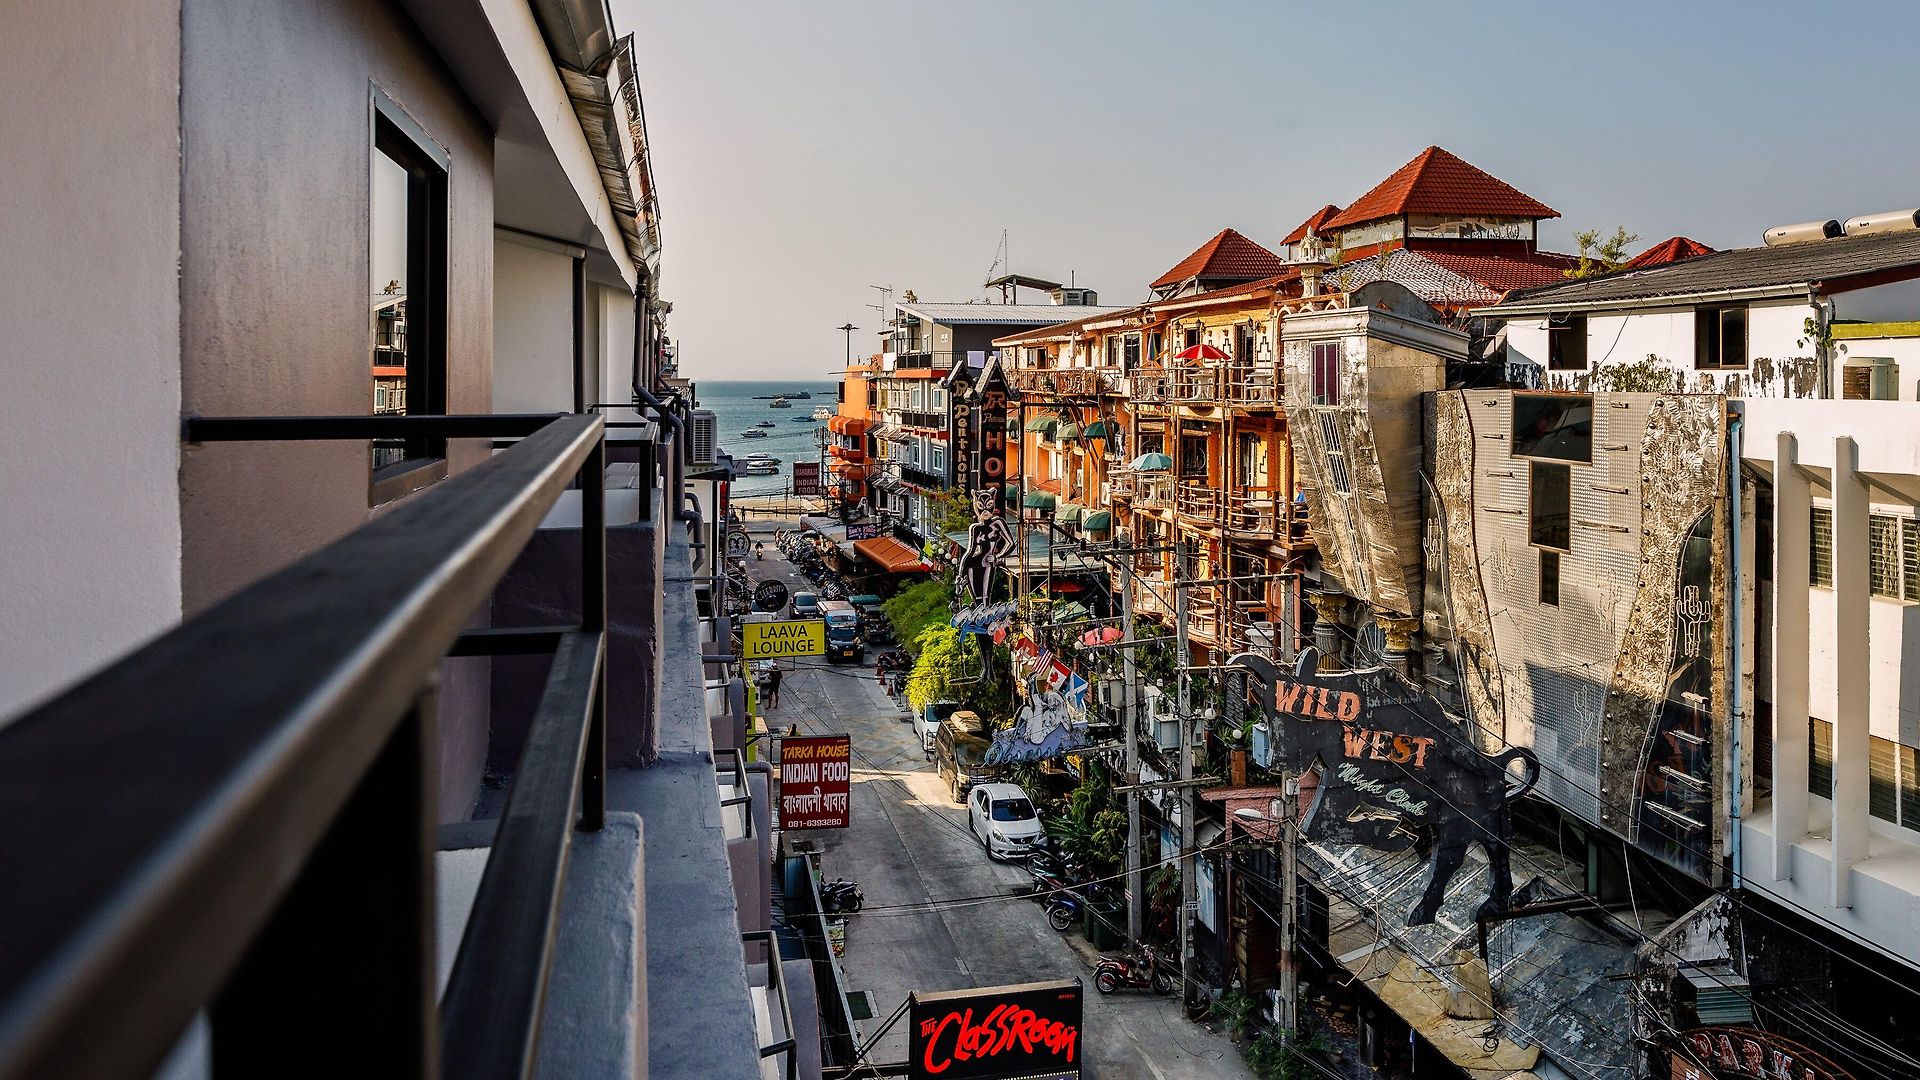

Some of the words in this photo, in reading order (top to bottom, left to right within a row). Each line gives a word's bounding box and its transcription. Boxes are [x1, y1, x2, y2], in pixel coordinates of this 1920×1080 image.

[796, 478, 818, 487] INDIAN
[798, 486, 816, 494] FOOD
[760, 624, 808, 639] LAAVA
[753, 639, 815, 654] LOUNGE
[1275, 679, 1362, 722] WILD
[782, 745, 814, 760] TARKA
[816, 744, 849, 759] HOUSE
[1343, 725, 1435, 770] WEST
[782, 762, 818, 784] INDIAN
[821, 761, 849, 782] FOOD
[783, 785, 822, 814] বাংলাদেশী
[823, 792, 848, 814] খাবার
[1385, 787, 1429, 816] Club
[920, 1017, 937, 1038] THE
